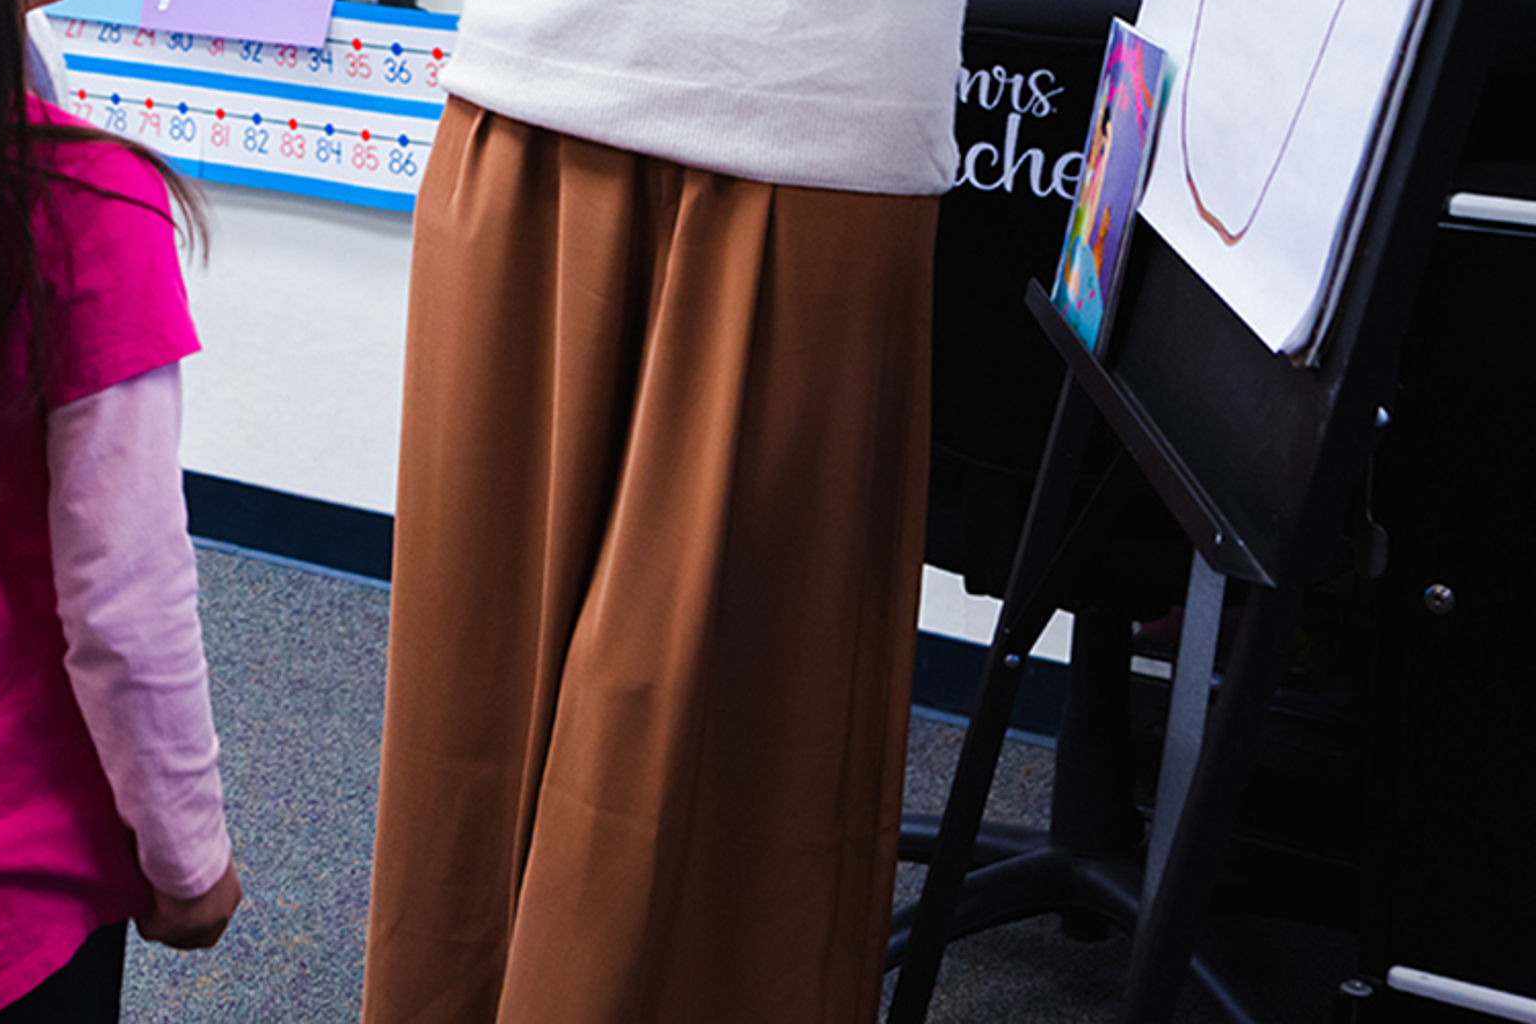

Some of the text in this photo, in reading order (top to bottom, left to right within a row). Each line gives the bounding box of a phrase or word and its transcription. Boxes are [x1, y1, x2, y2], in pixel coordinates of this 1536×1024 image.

[239, 39, 264, 63] 32
[273, 43, 299, 68] 33
[308, 47, 333, 73] 34
[345, 53, 373, 80] 35
[384, 57, 412, 85] 36
[105, 106, 128, 132] 78
[138, 112, 162, 137] 79
[169, 117, 197, 142] 80
[210, 122, 232, 147] 81
[243, 127, 270, 155] 82
[280, 133, 307, 159] 83
[315, 138, 343, 165] 84
[352, 144, 380, 171] 85
[388, 150, 419, 178] 86
